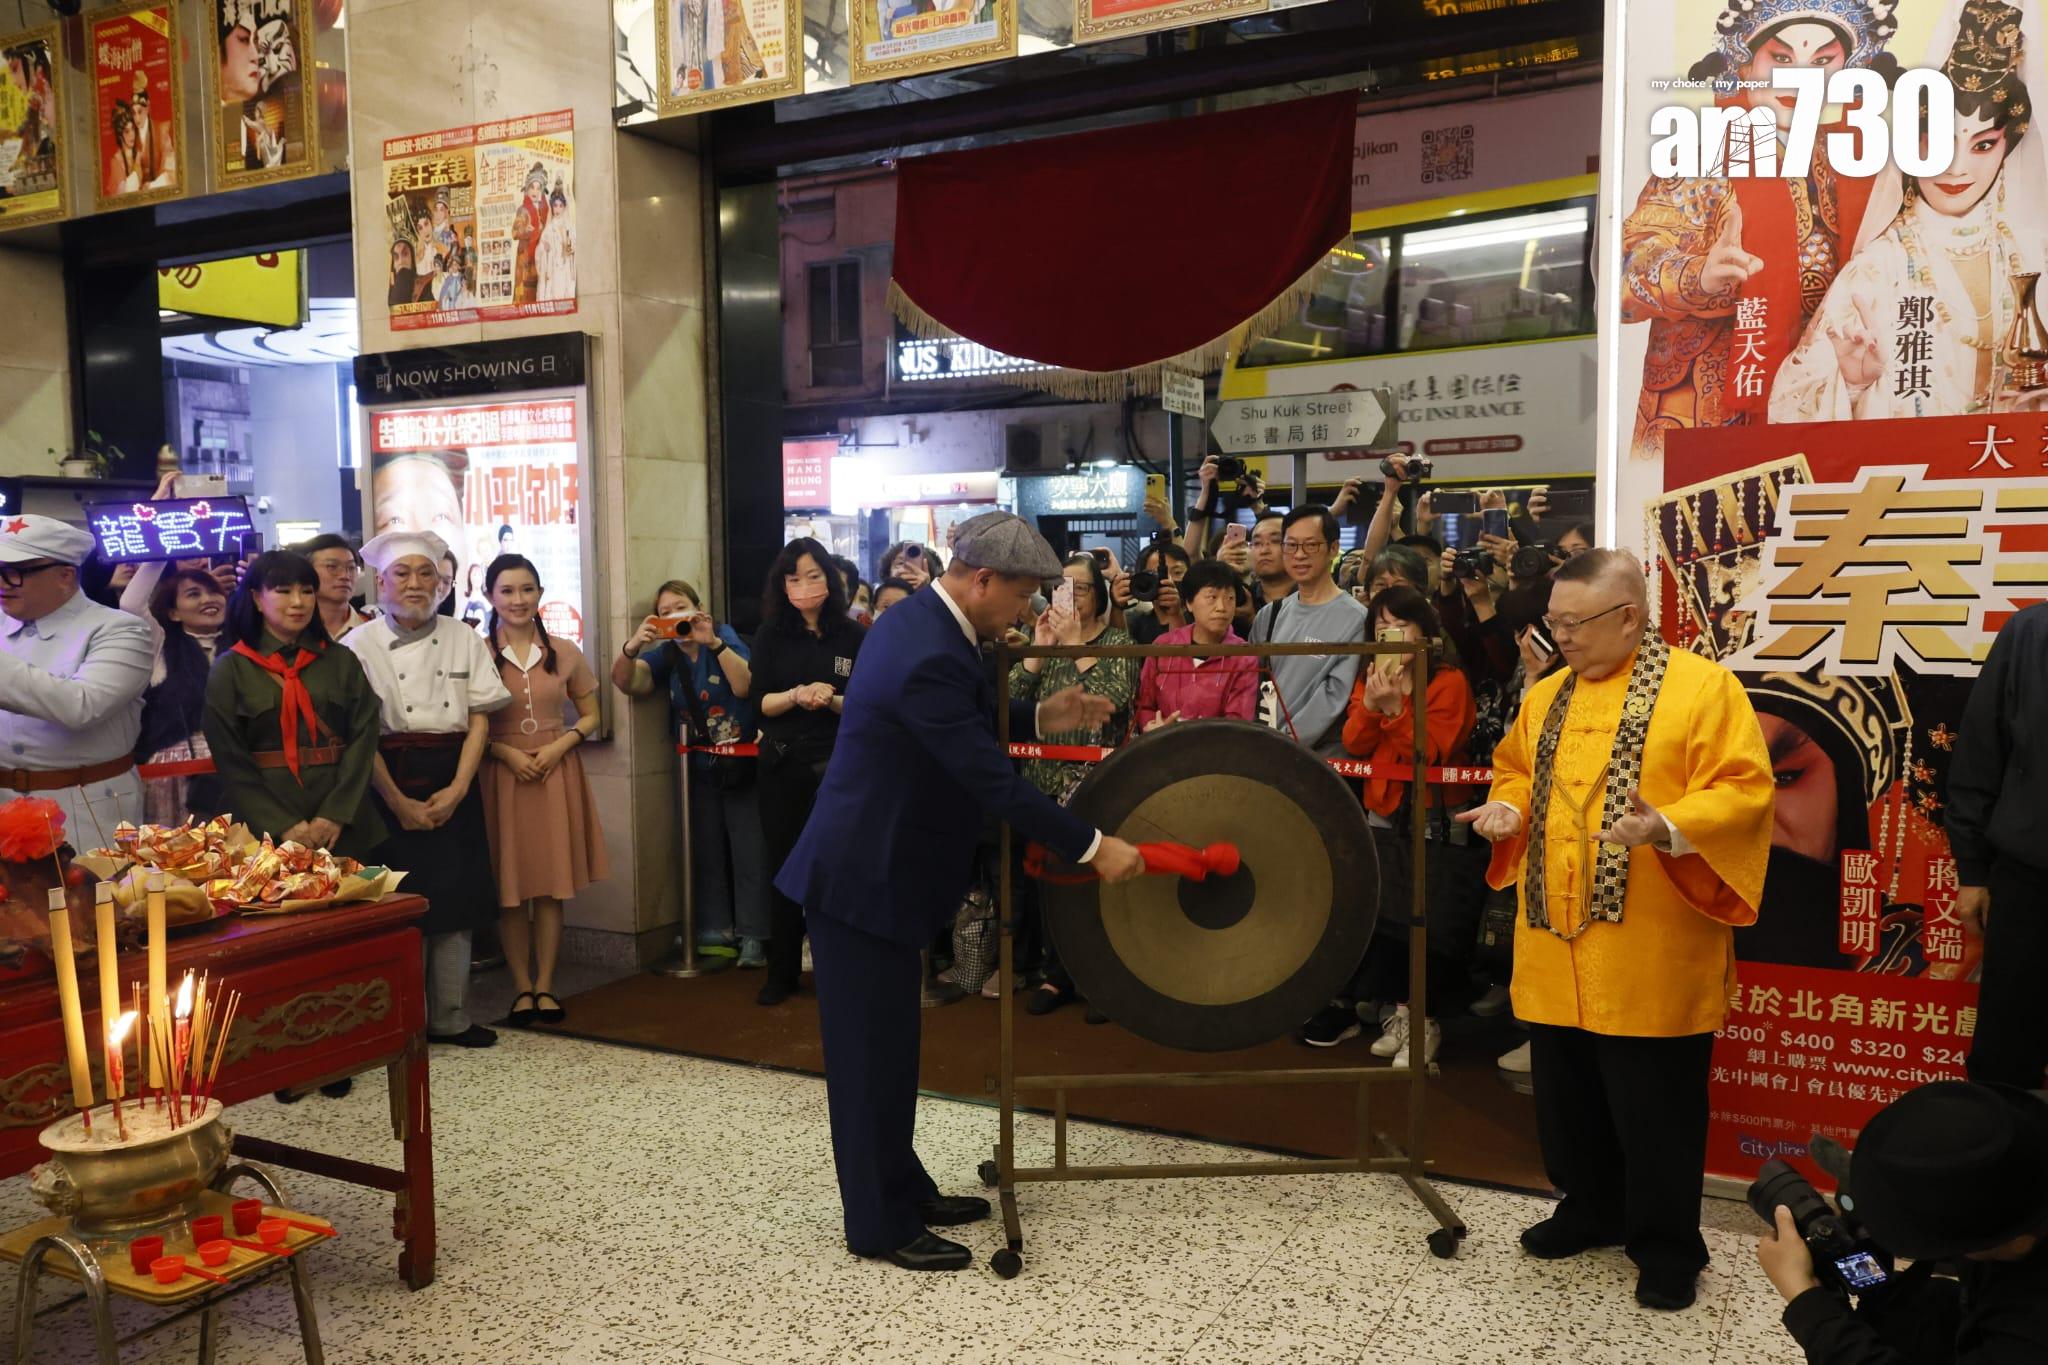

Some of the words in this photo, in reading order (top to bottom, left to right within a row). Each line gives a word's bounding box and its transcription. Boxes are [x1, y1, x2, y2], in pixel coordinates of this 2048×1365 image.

[1733, 297, 1768, 398] 藍天佑
[1893, 295, 1935, 399] 鄭雅琪
[395, 369, 439, 387] NOW
[443, 358, 535, 383] SHOWING
[541, 355, 555, 372] 日
[1241, 407, 1267, 420] Shu
[1273, 404, 1300, 418] Kuk
[1306, 401, 1353, 416] Street
[1426, 401, 1526, 422] INSURANCE
[1263, 424, 1328, 445] 書局街
[1346, 427, 1361, 438] 27
[465, 463, 578, 525] 小平你好
[787, 475, 822, 485] HEUNG
[1842, 853, 1879, 953] 歐凱明
[1926, 858, 1963, 961] 蔣文端
[1746, 1048, 1827, 1071] 網上購票
[1780, 1031, 1835, 1051] $400
[1850, 1038, 1906, 1059] $320
